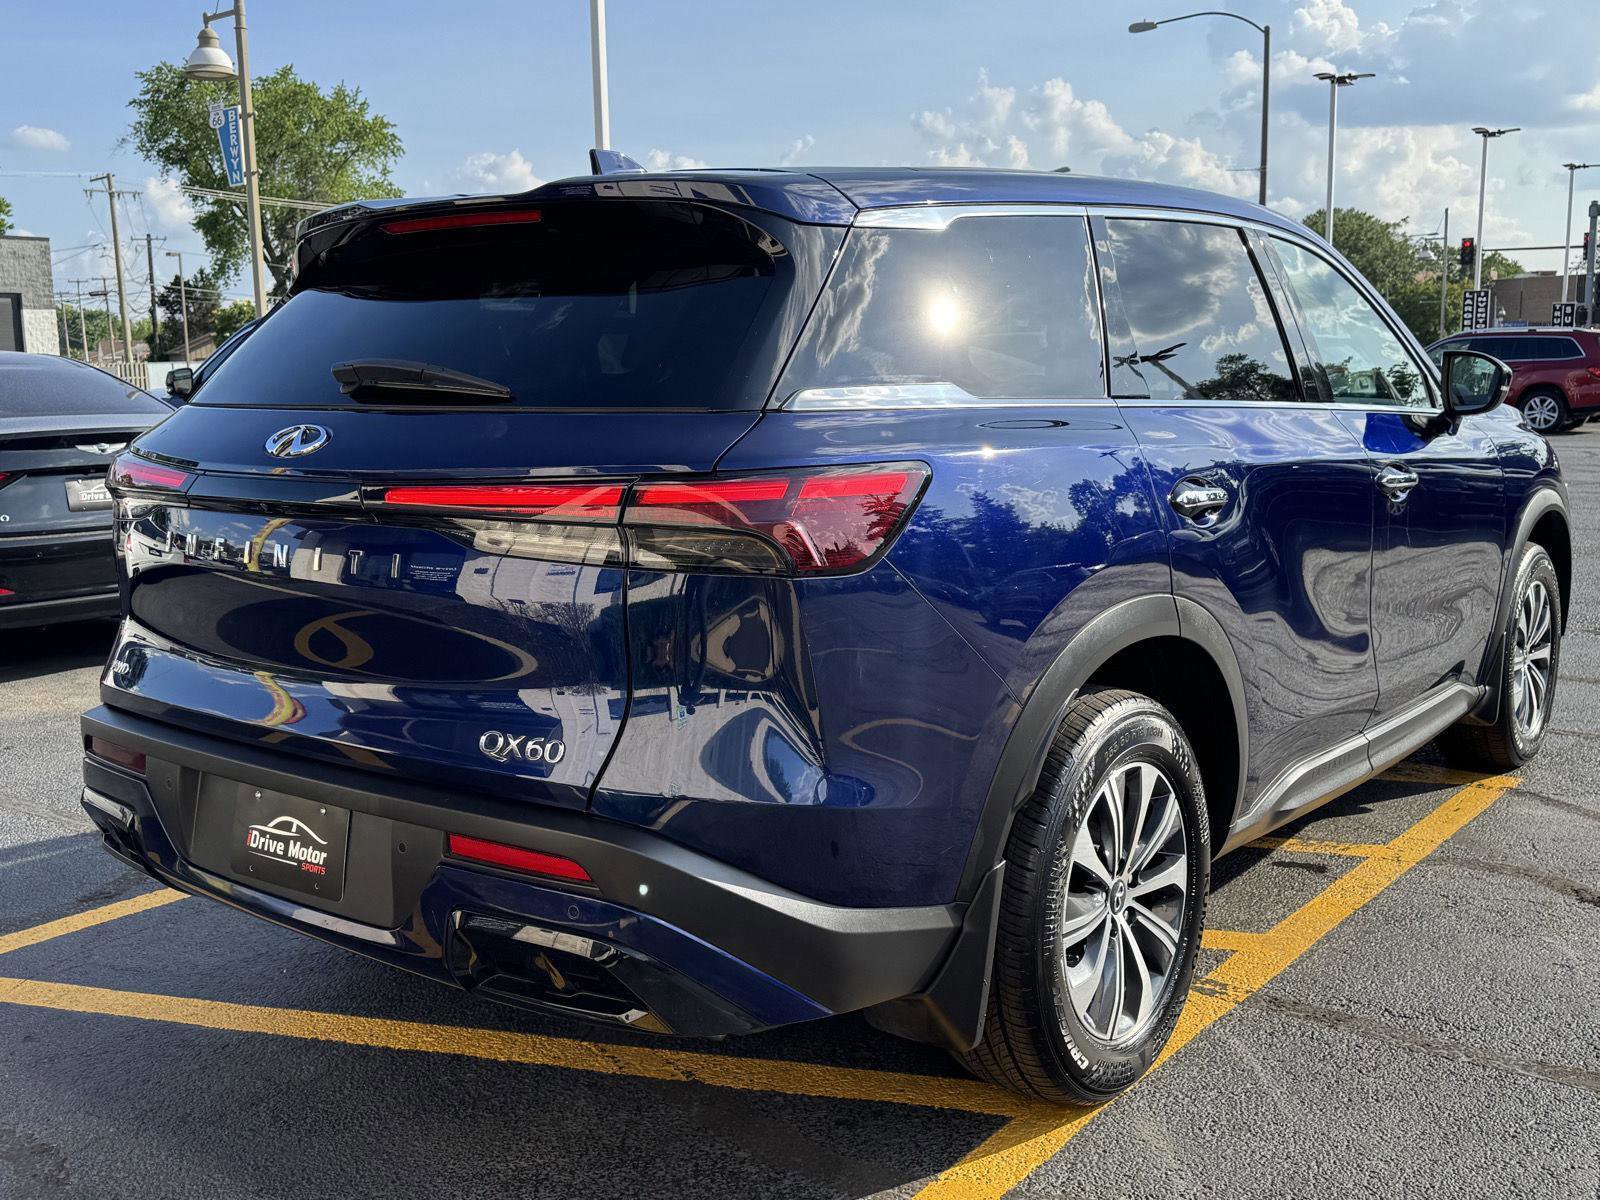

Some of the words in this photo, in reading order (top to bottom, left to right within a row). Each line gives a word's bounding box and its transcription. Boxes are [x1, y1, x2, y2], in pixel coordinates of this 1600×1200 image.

[213, 116, 222, 127] 66
[228, 110, 241, 183] BERWYN
[165, 530, 400, 579] INFINITI
[479, 730, 565, 763] QX60
[247, 829, 285, 855] iDrive
[287, 840, 328, 865] Motor
[301, 862, 326, 875] SPORTS
